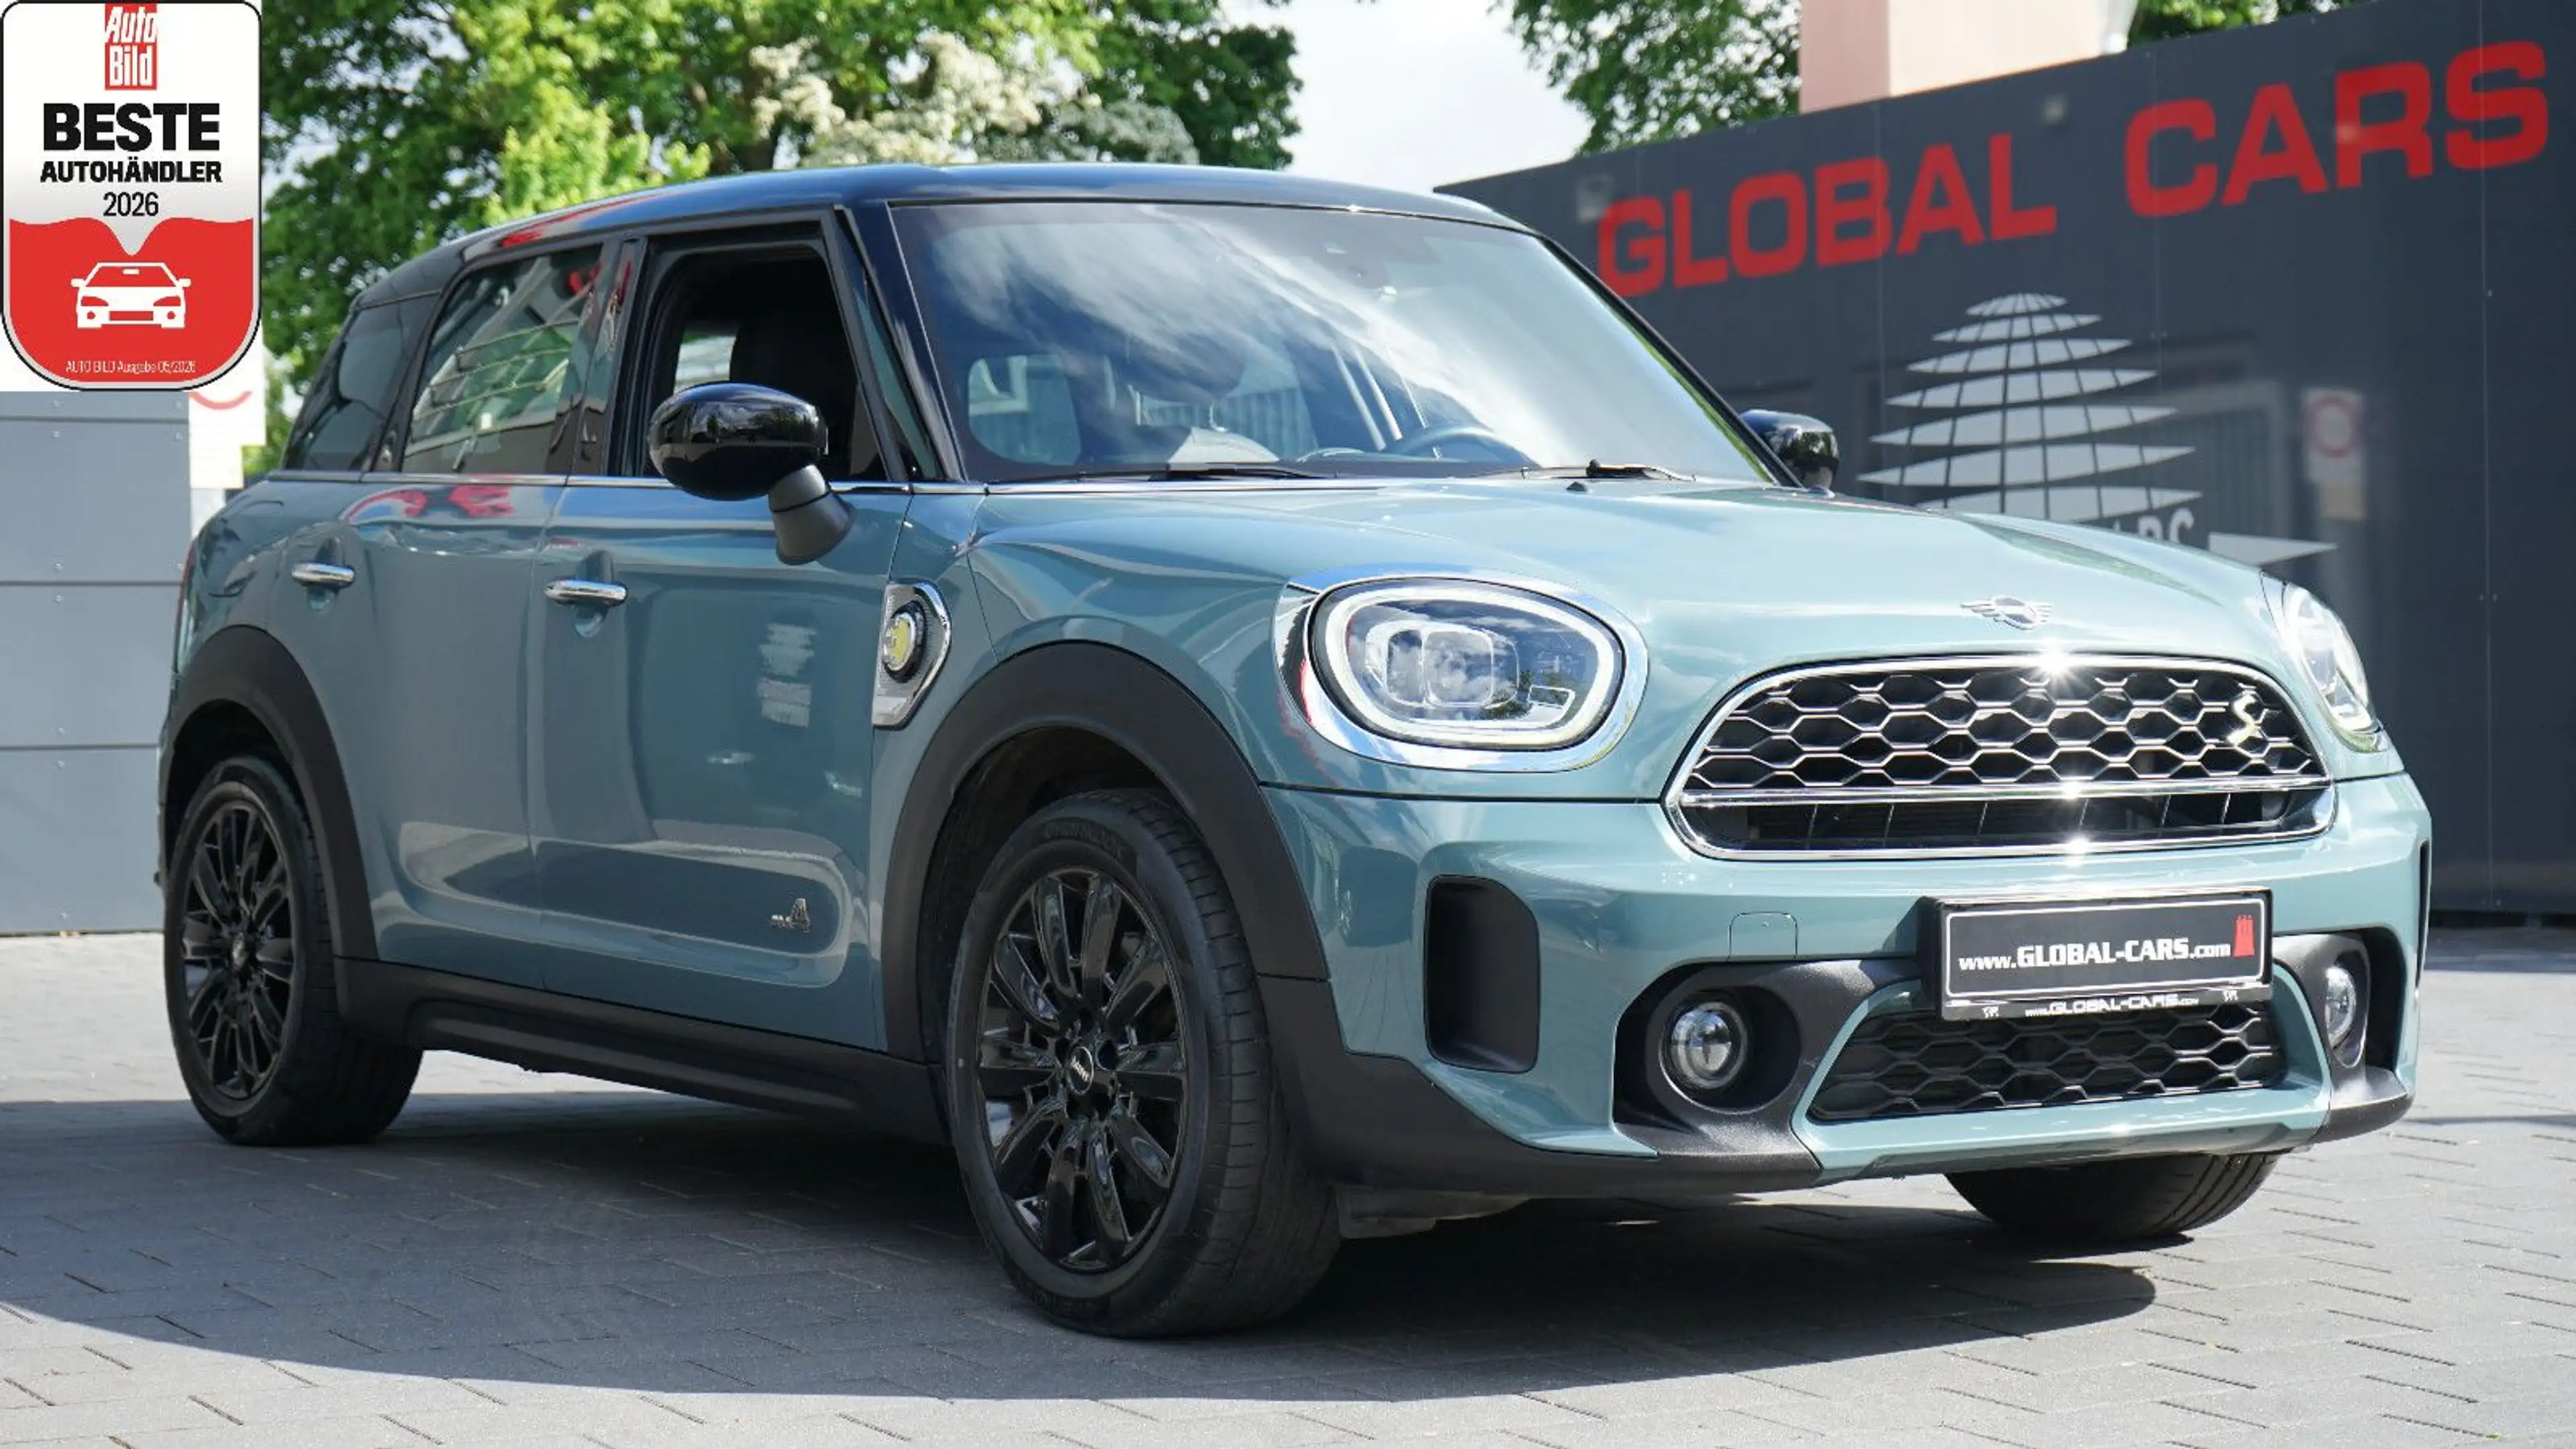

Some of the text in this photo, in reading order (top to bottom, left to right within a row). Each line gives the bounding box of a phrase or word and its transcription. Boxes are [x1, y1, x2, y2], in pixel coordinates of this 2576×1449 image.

[1599, 41, 2548, 298] GLOBAL CARS
[1958, 936, 2232, 971] www.GLOBAL-CARS.com
